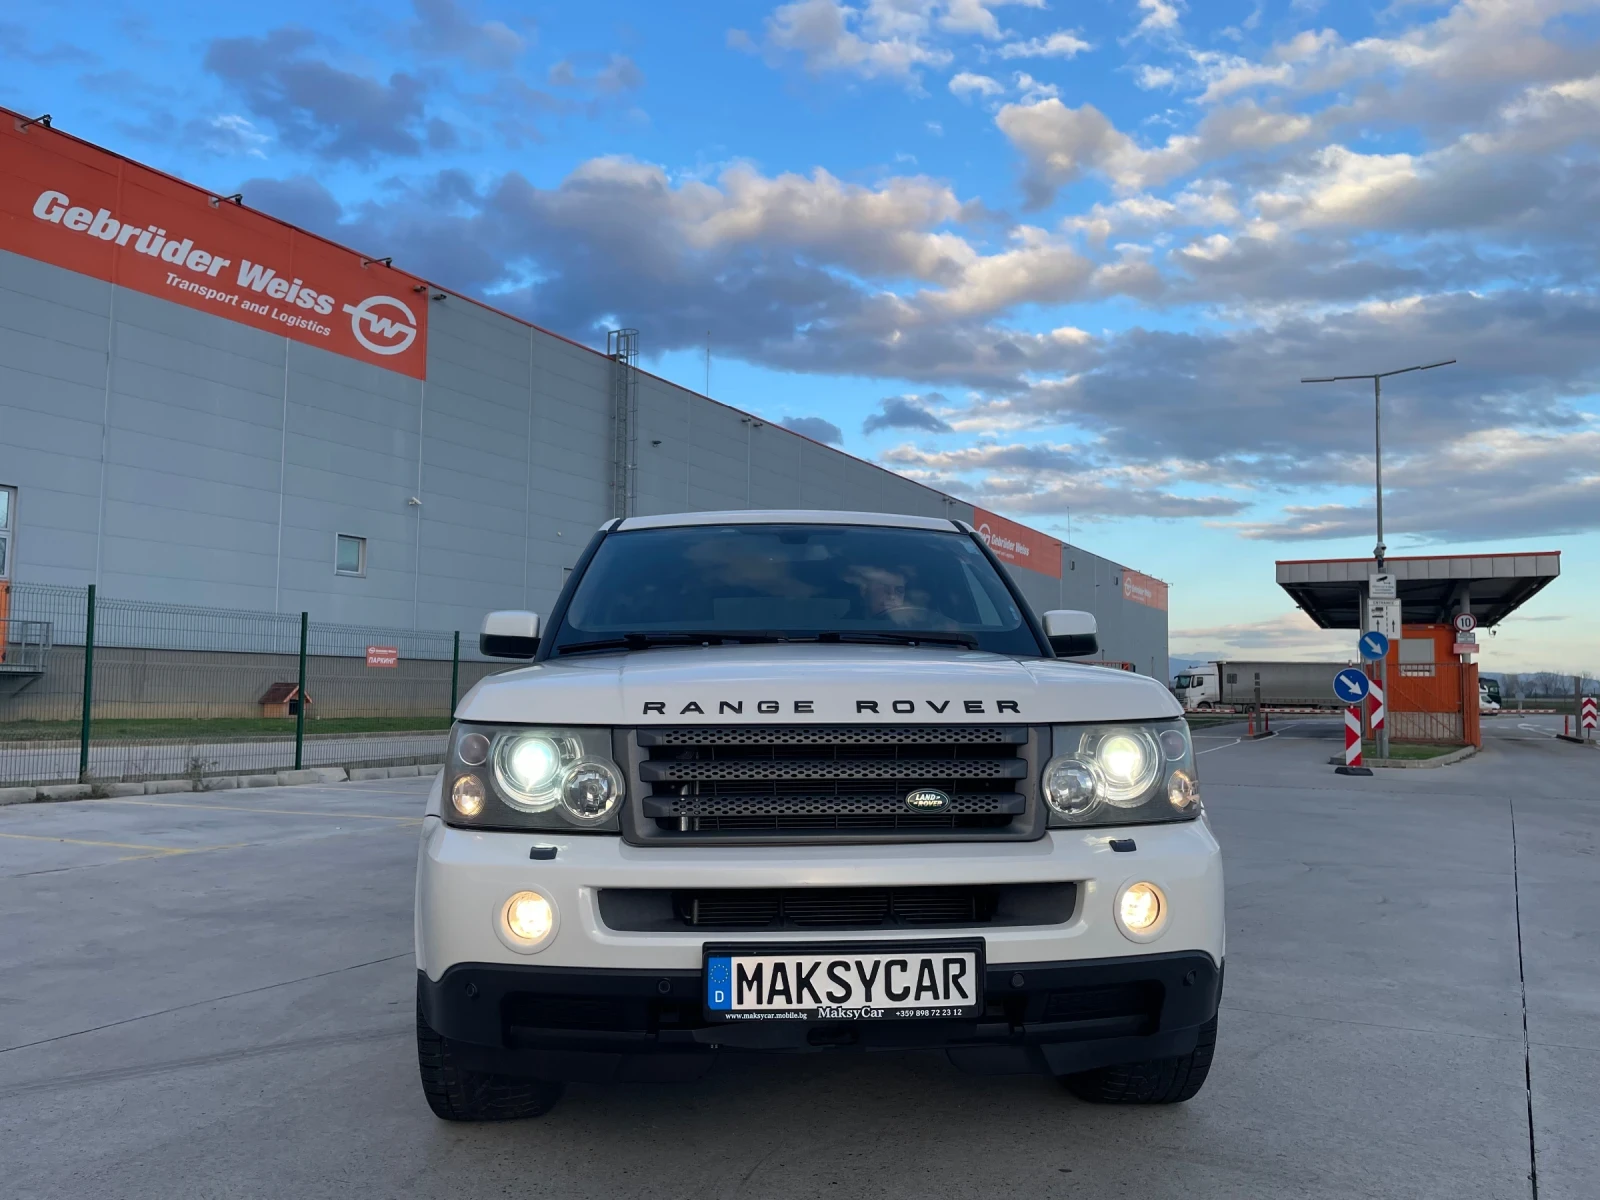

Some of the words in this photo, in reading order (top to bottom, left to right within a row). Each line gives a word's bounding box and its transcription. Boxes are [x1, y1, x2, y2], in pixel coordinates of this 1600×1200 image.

[33, 190, 230, 278] Gebrüder
[237, 259, 335, 315] Weiss
[165, 272, 238, 307] Transport
[241, 300, 268, 315] and
[271, 306, 331, 337] Logistics
[1460, 617, 1471, 628] 10
[642, 700, 815, 715] RANGE
[856, 700, 1021, 714] ROVER
[736, 958, 969, 1005] MAKSYCAR
[714, 990, 724, 1003] D
[725, 1011, 808, 1020] www.maksycar.mobile.bg
[817, 1006, 884, 1020] MaksyCar
[895, 1009, 914, 1017] +359
[915, 1009, 929, 1017] 898
[953, 1008, 963, 1016] 12
